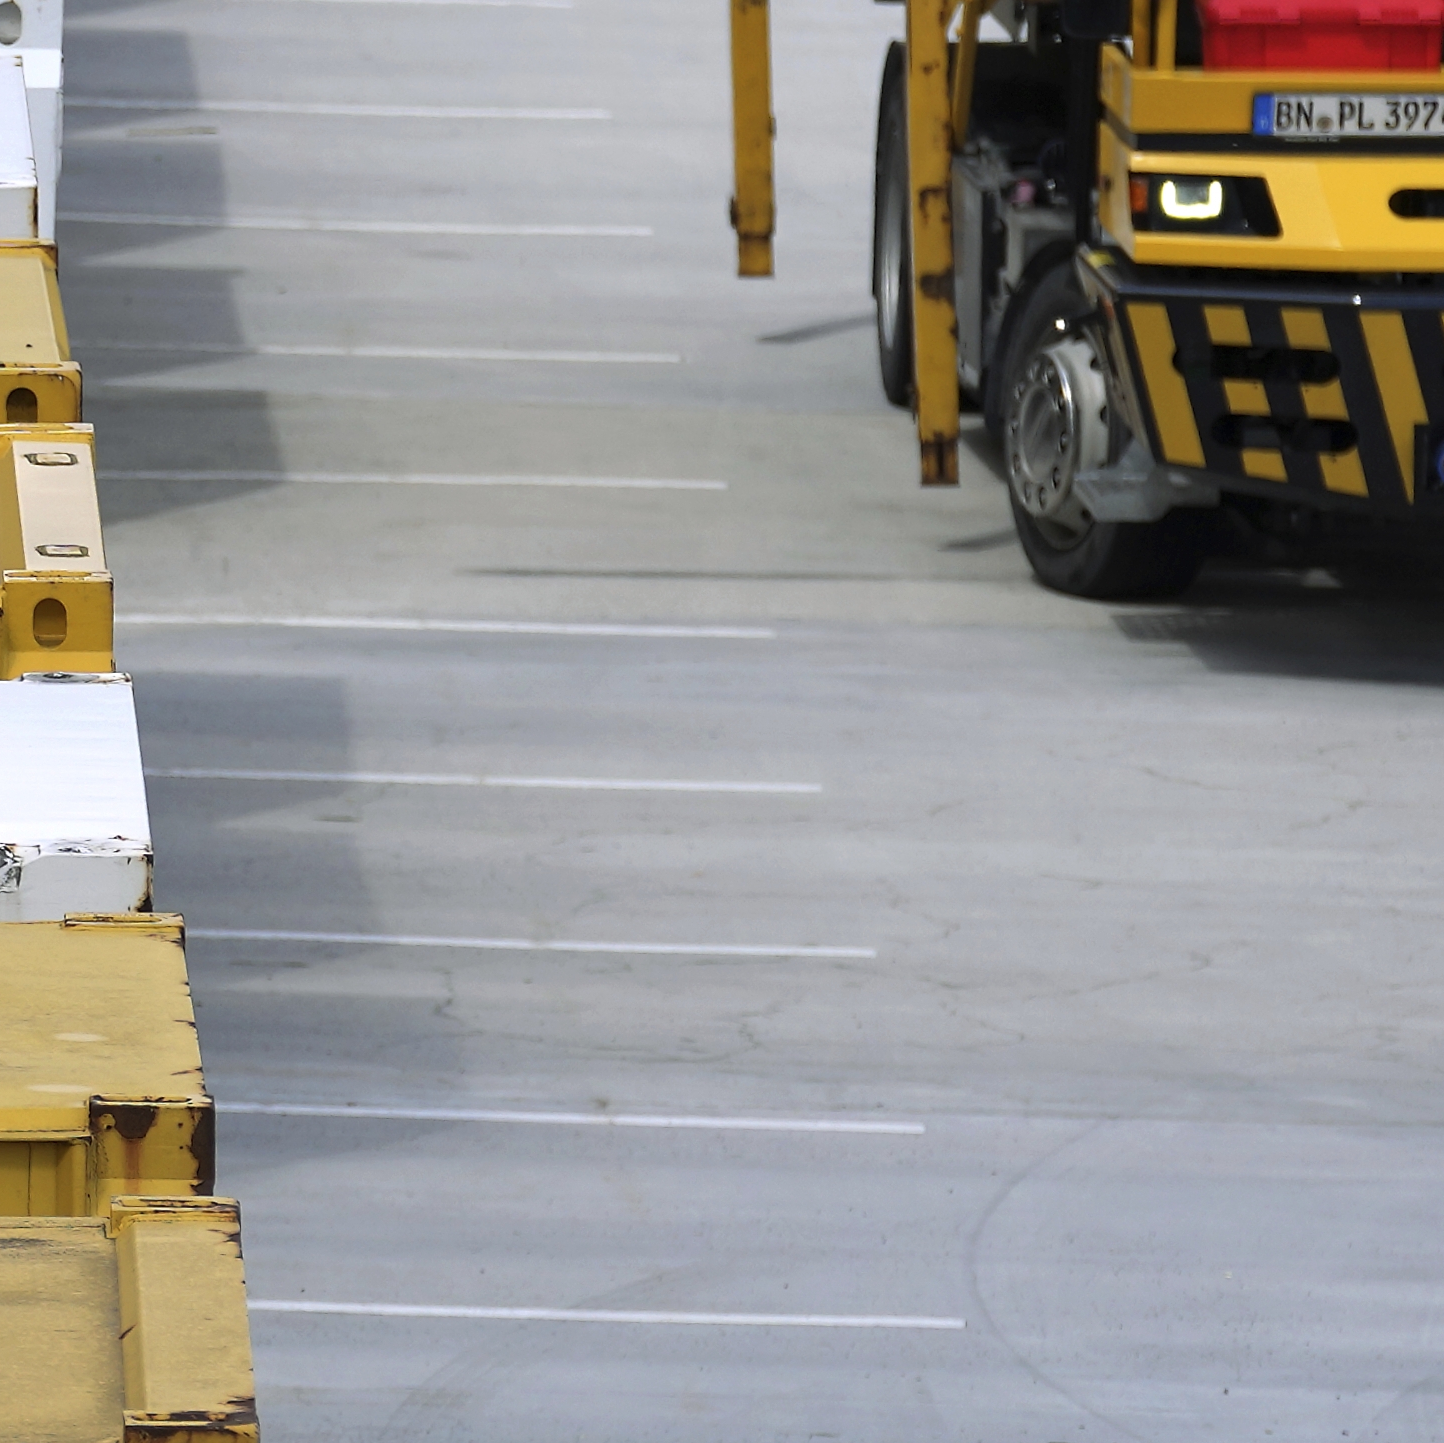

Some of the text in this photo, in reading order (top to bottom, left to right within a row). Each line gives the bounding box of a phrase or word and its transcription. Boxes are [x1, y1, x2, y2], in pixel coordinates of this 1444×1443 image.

[1276, 101, 1314, 131] BN
[1339, 101, 1375, 131] PL
[1385, 101, 1444, 131] 397
